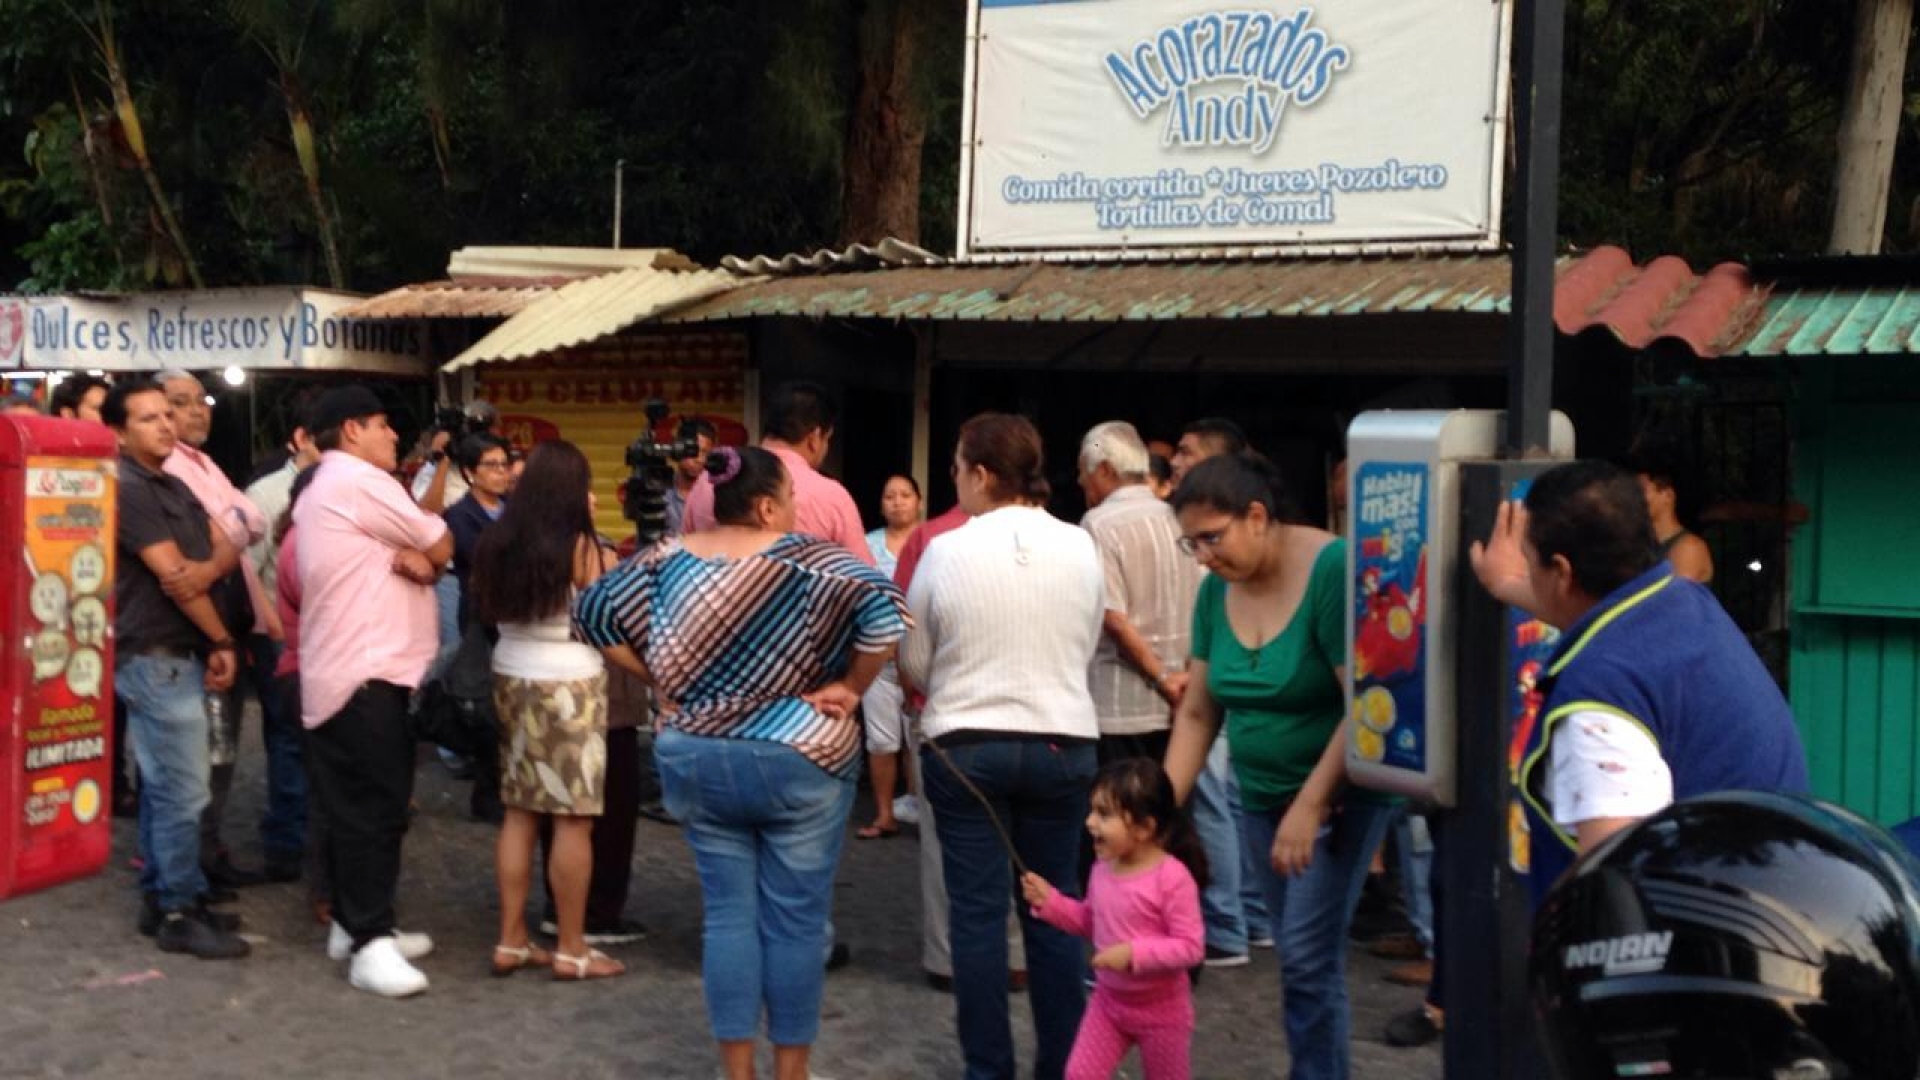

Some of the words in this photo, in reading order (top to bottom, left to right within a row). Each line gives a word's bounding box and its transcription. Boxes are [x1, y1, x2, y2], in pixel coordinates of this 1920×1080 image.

[1105, 9, 1349, 108] Acorazados
[1165, 89, 1284, 149] Andy
[1002, 174, 1098, 204] Comida
[1103, 170, 1202, 198] corrida
[1320, 160, 1447, 193] Pozolero
[1096, 200, 1200, 229] Tortillas
[1206, 198, 1240, 225] de
[1244, 193, 1334, 224] Comal
[31, 306, 137, 357] Dulces,
[147, 307, 270, 353] Refrescos
[279, 318, 295, 359] y
[302, 302, 421, 356] Botanas
[1565, 930, 1675, 977] NOLAN
